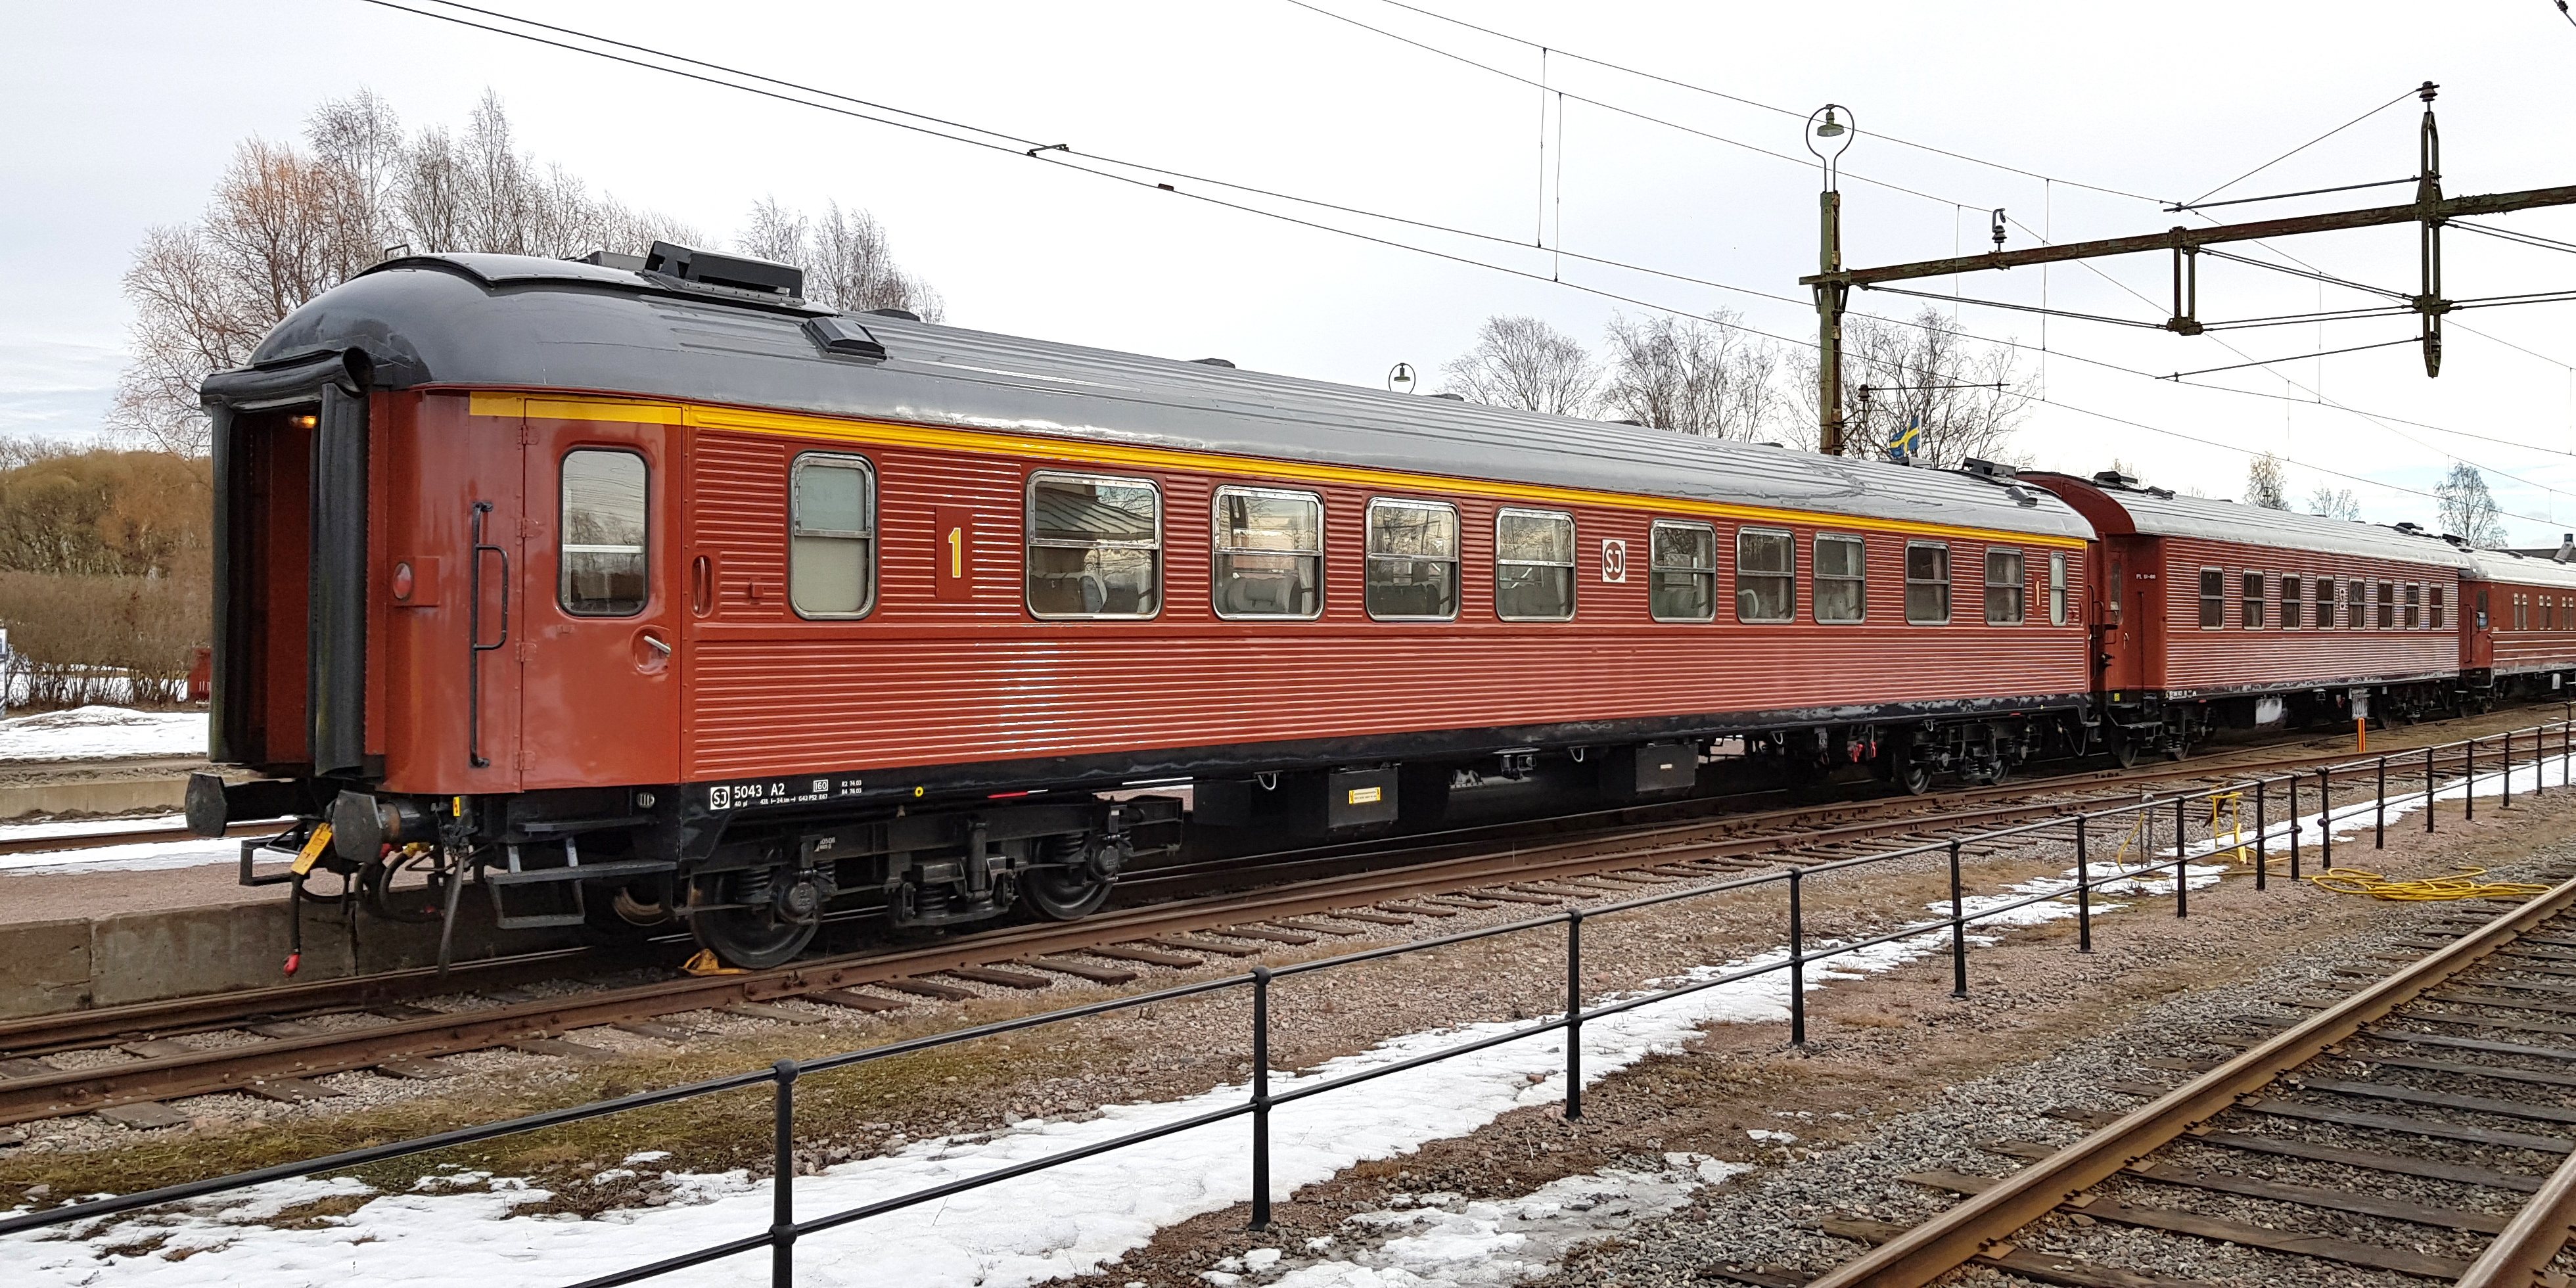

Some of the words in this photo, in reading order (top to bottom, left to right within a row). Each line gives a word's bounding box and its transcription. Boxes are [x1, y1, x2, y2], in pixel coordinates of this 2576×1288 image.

[948, 528, 961, 578] 1
[2035, 580, 2040, 606] 1
[735, 785, 762, 798] 5043
[770, 783, 785, 796] A2
